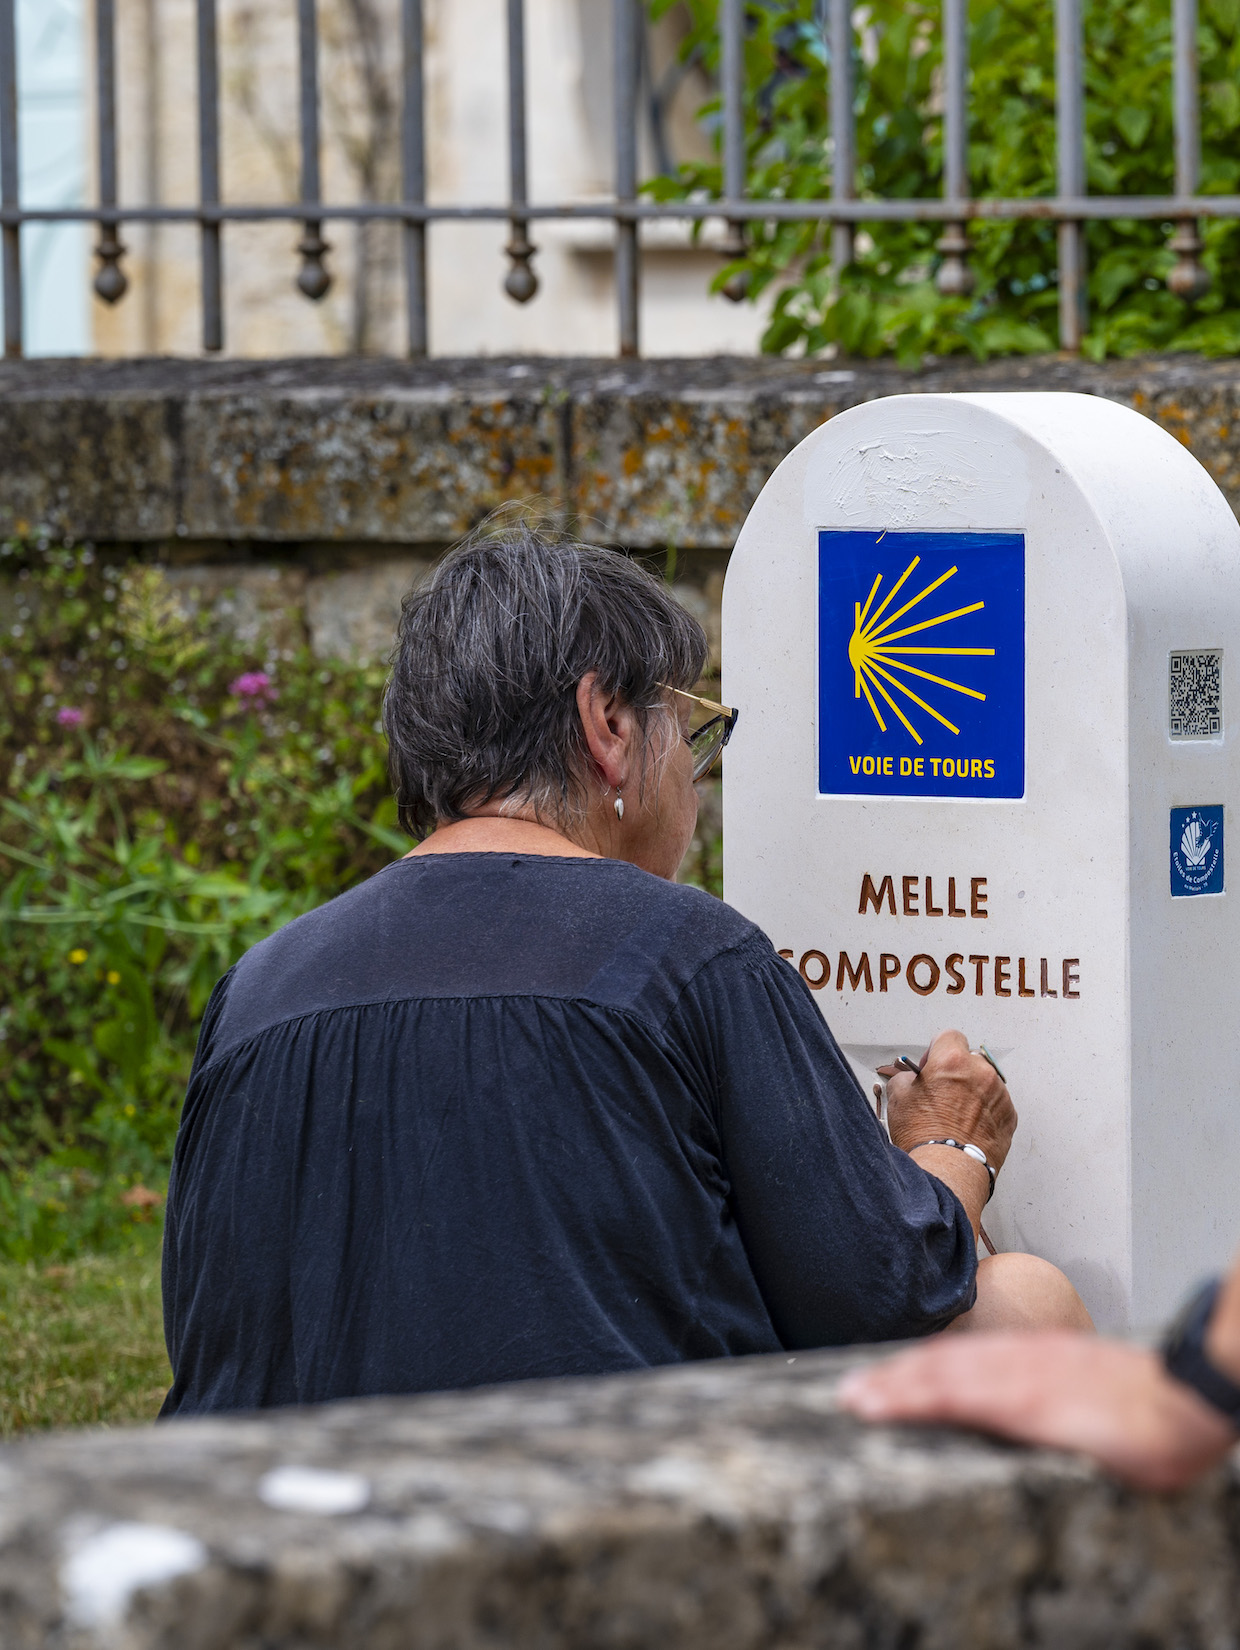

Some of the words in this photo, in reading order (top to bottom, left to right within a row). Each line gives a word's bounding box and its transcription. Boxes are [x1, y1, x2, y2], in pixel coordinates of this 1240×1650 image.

[849, 756, 894, 775] VOIE
[900, 757, 925, 776] DE
[930, 758, 995, 778] TOURS
[1185, 875, 1192, 883] de
[1193, 848, 1219, 884] Compostelle
[858, 874, 988, 918] MELLE
